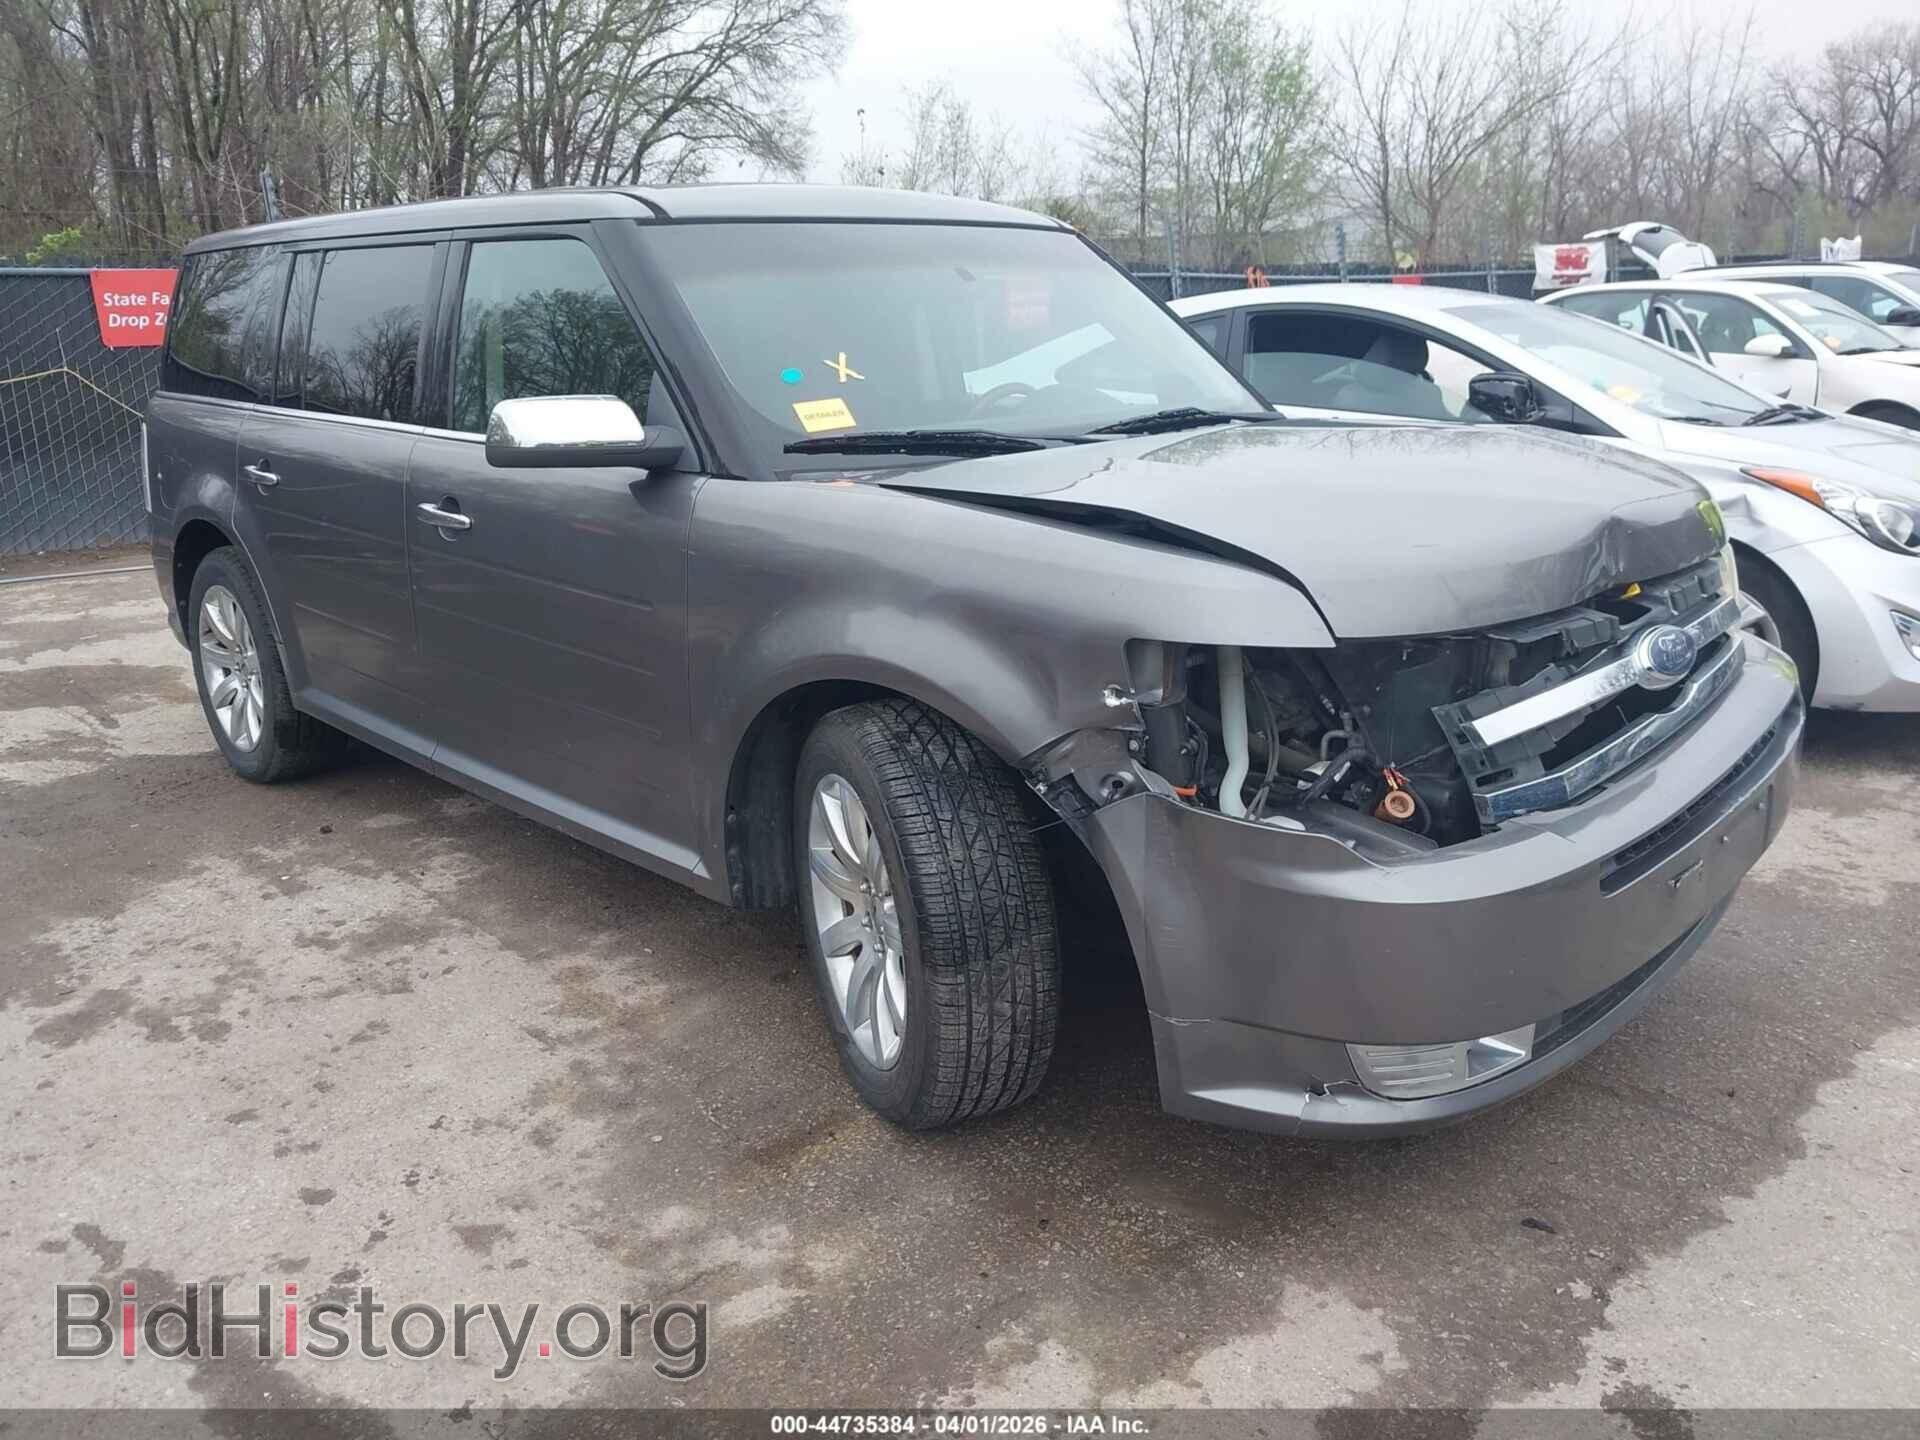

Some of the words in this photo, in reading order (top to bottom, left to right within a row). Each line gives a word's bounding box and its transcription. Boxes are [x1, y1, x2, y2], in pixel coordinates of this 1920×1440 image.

[103, 292, 147, 307] State
[152, 291, 170, 305] Fa
[108, 313, 150, 330] Drop
[154, 311, 168, 326] Z
